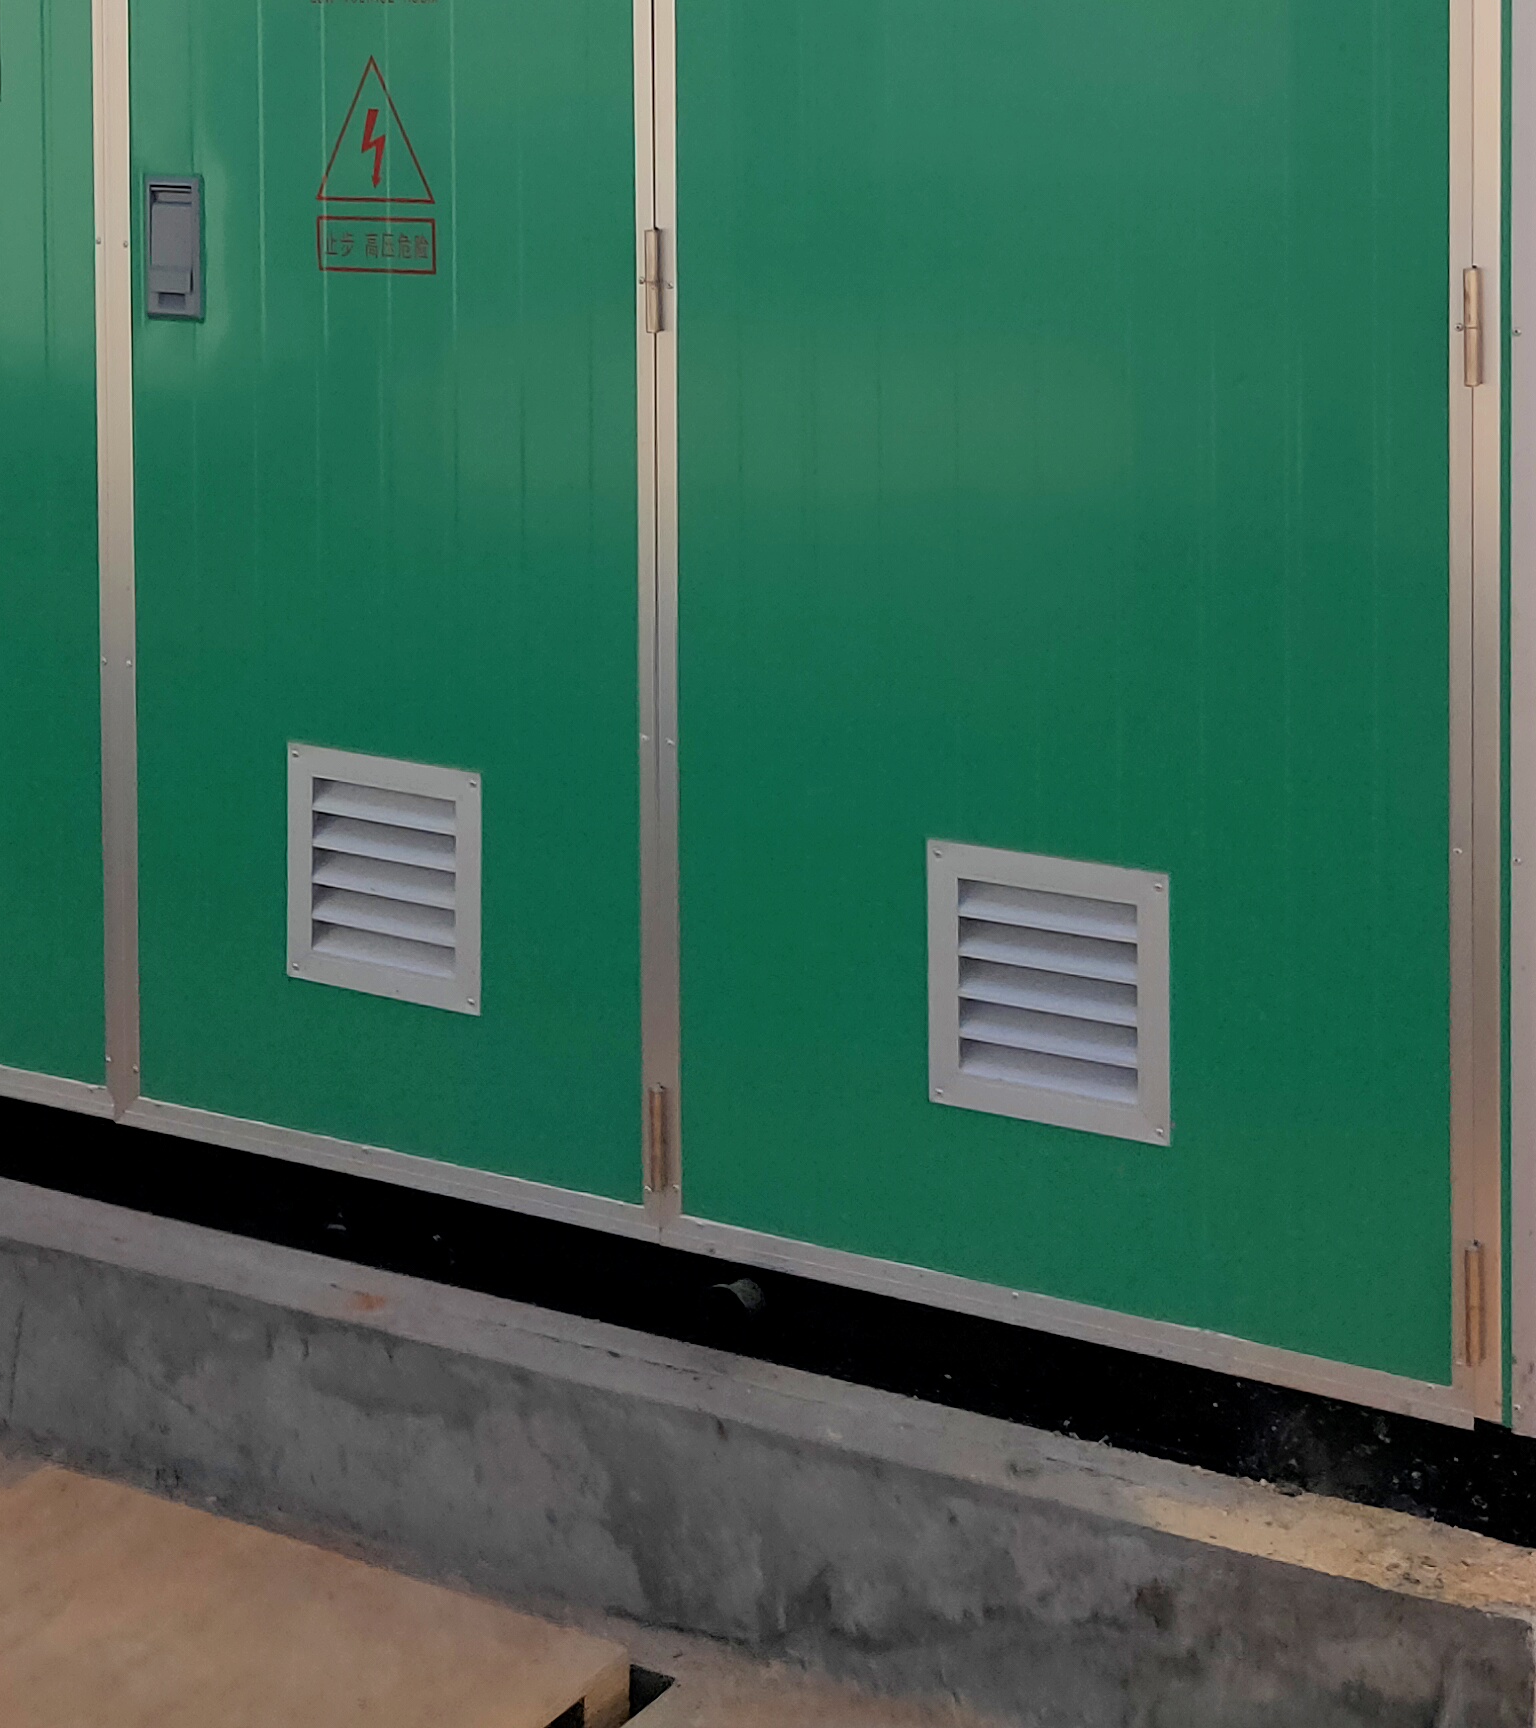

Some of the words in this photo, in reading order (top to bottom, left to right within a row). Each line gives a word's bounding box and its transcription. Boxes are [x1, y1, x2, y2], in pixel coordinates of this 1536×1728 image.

[326, 232, 354, 257] 止步
[365, 232, 429, 259] 高压危险
